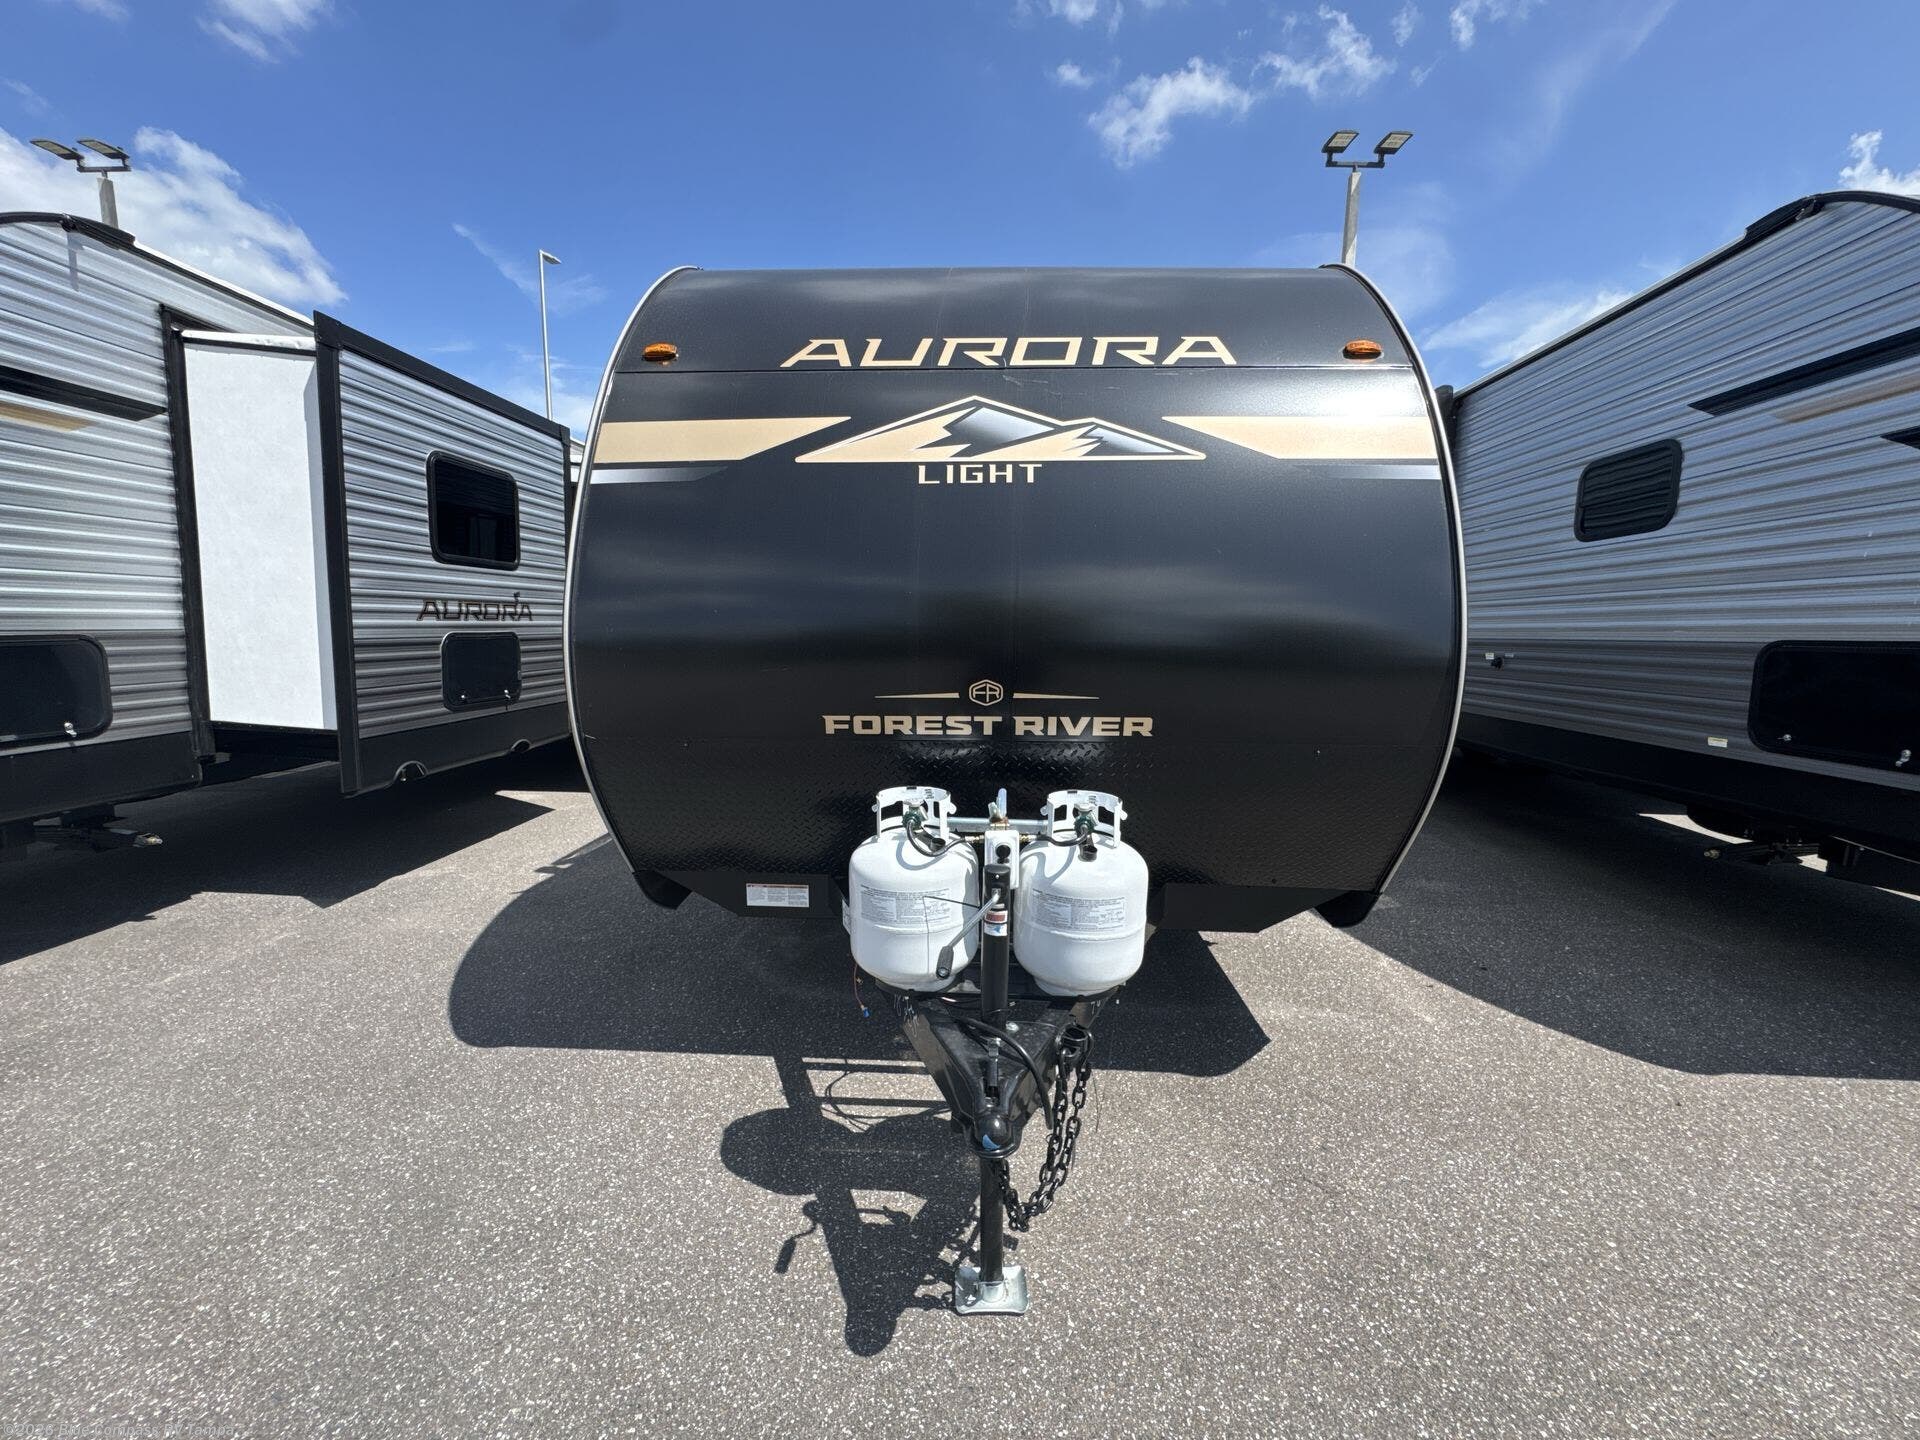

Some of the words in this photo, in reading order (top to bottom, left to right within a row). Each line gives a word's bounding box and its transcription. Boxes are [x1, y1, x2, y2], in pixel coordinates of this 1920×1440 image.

[779, 336, 1238, 368] AURORA
[917, 463, 1043, 485] LIGHT
[416, 599, 533, 621] AURORA
[821, 714, 1003, 736] FOREST
[1012, 715, 1154, 737] RIVER
